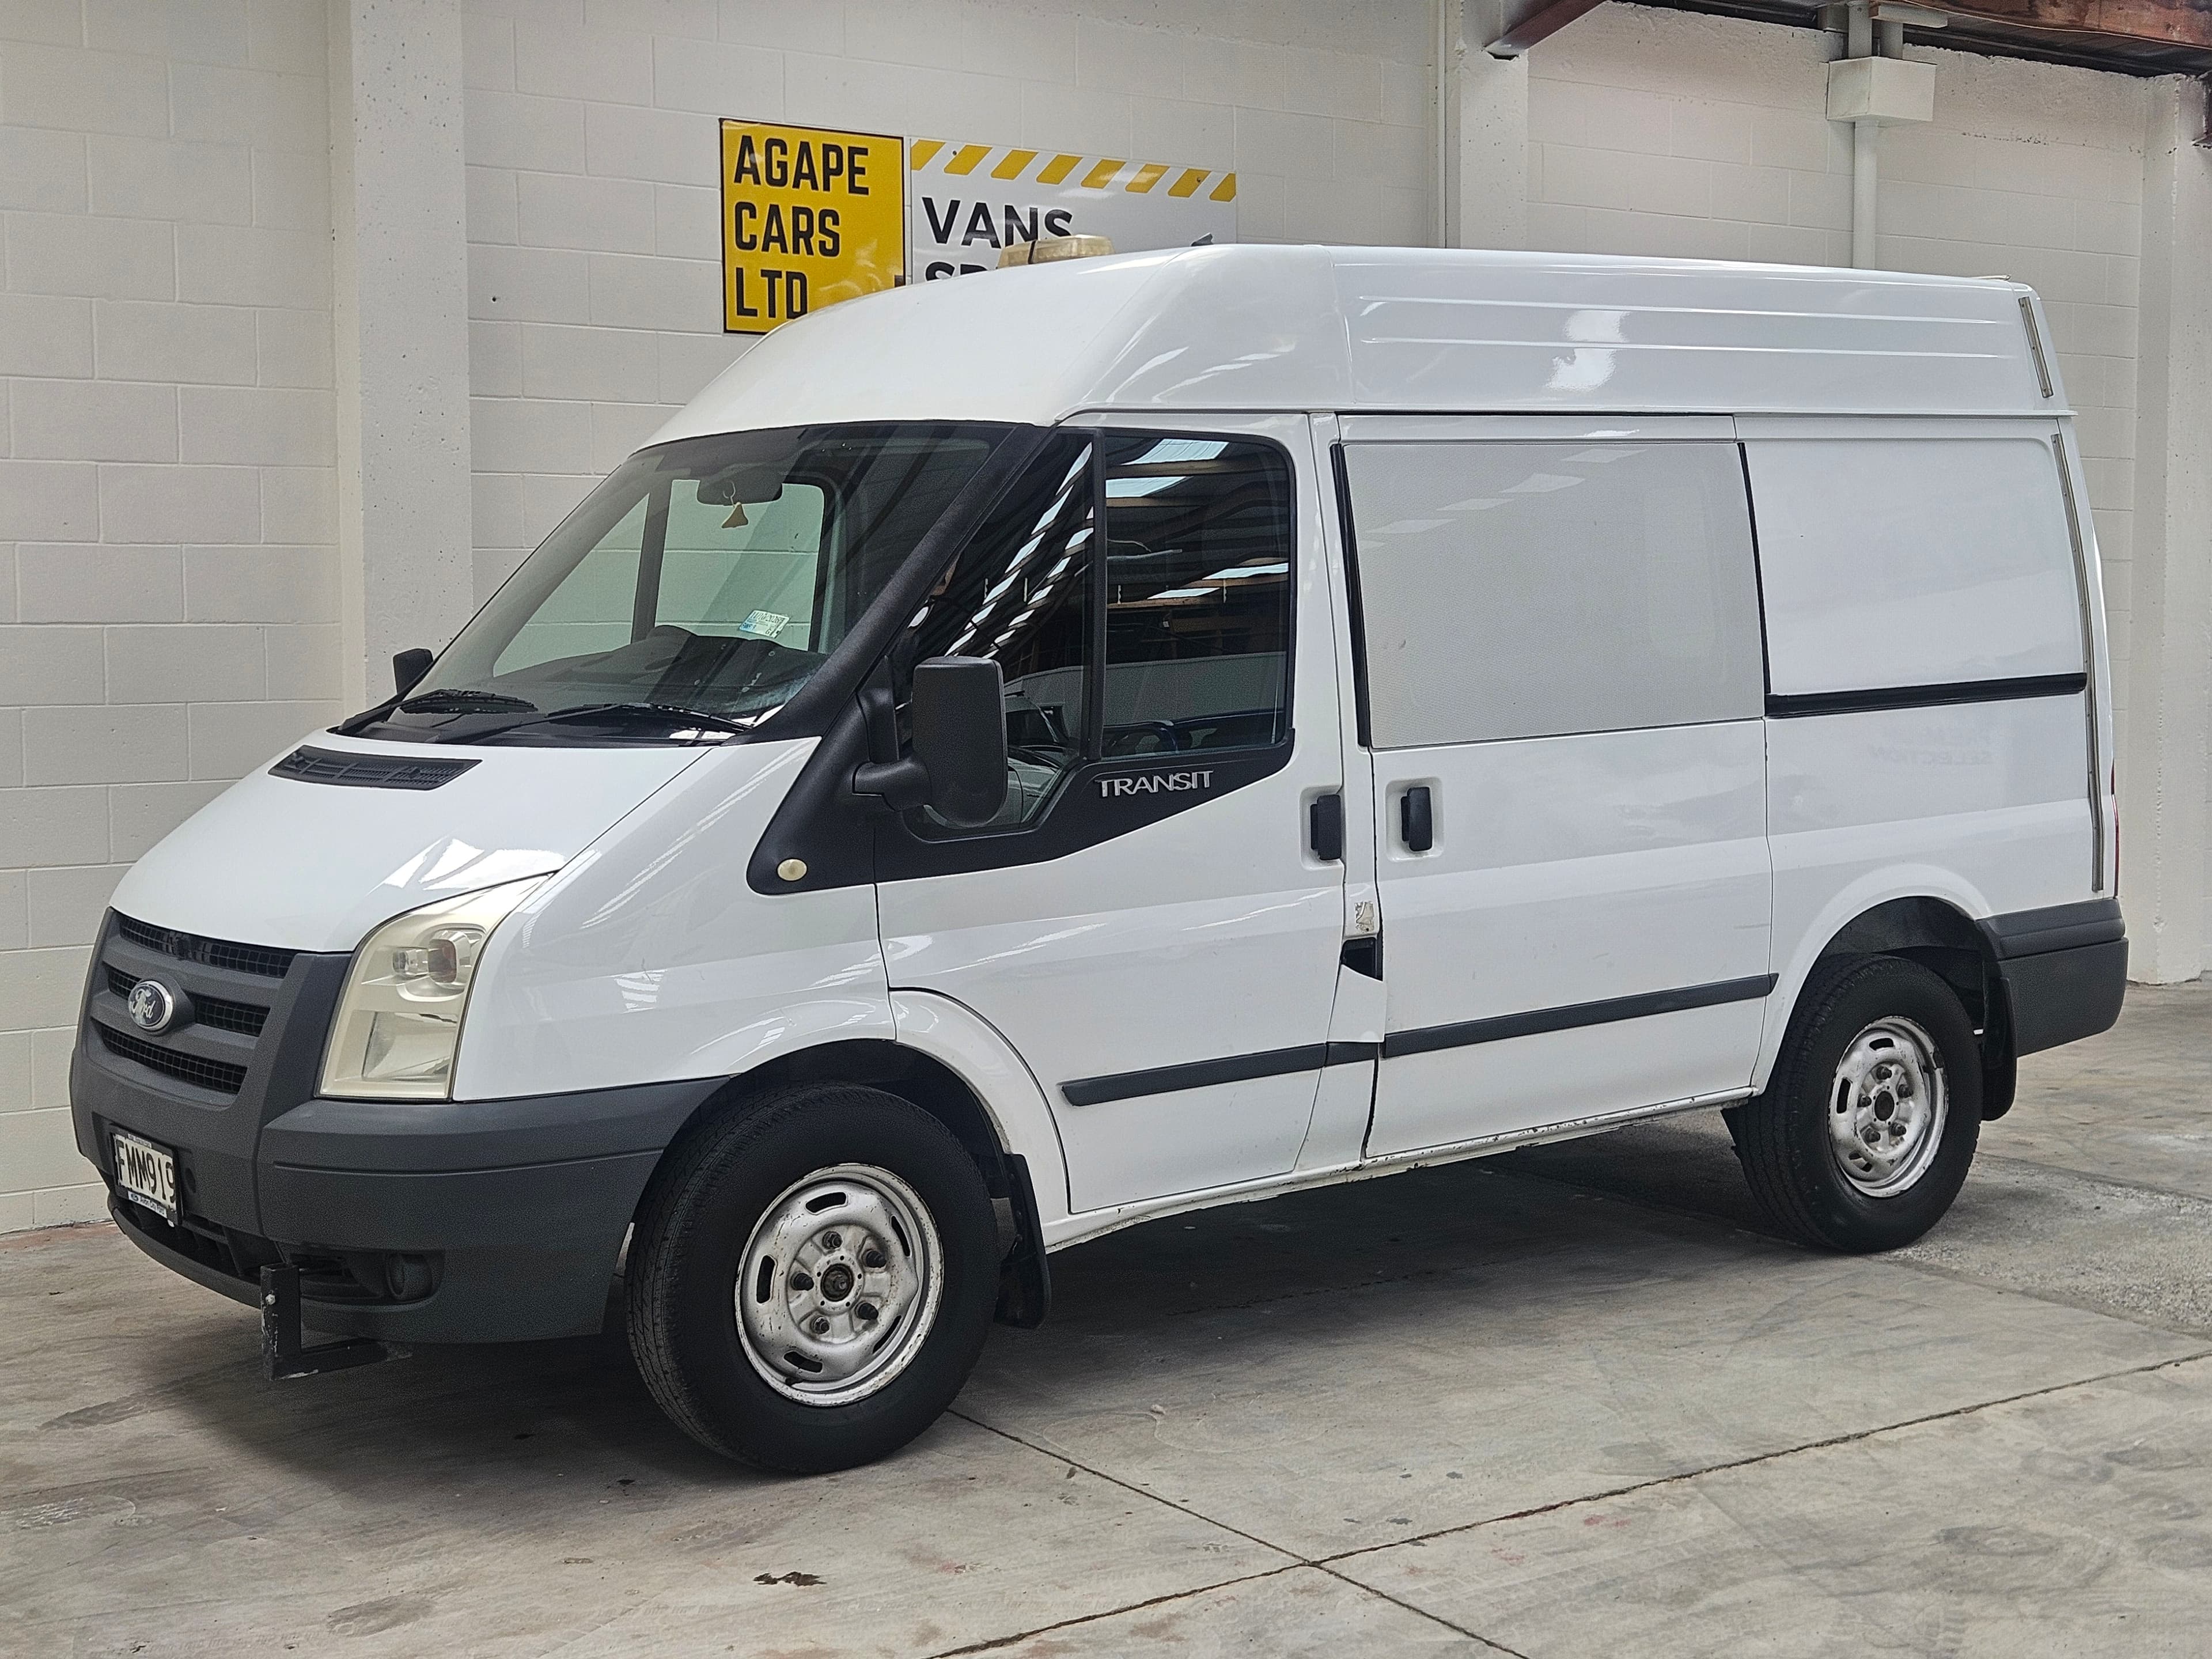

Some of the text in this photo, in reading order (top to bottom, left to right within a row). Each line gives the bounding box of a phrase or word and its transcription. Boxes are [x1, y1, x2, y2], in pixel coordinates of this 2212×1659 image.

[734, 135, 869, 195] AGAPE
[734, 201, 840, 257] CARS
[922, 197, 1073, 248] VANS
[736, 267, 808, 320] LTD
[1095, 770, 1214, 797] TRANSIT
